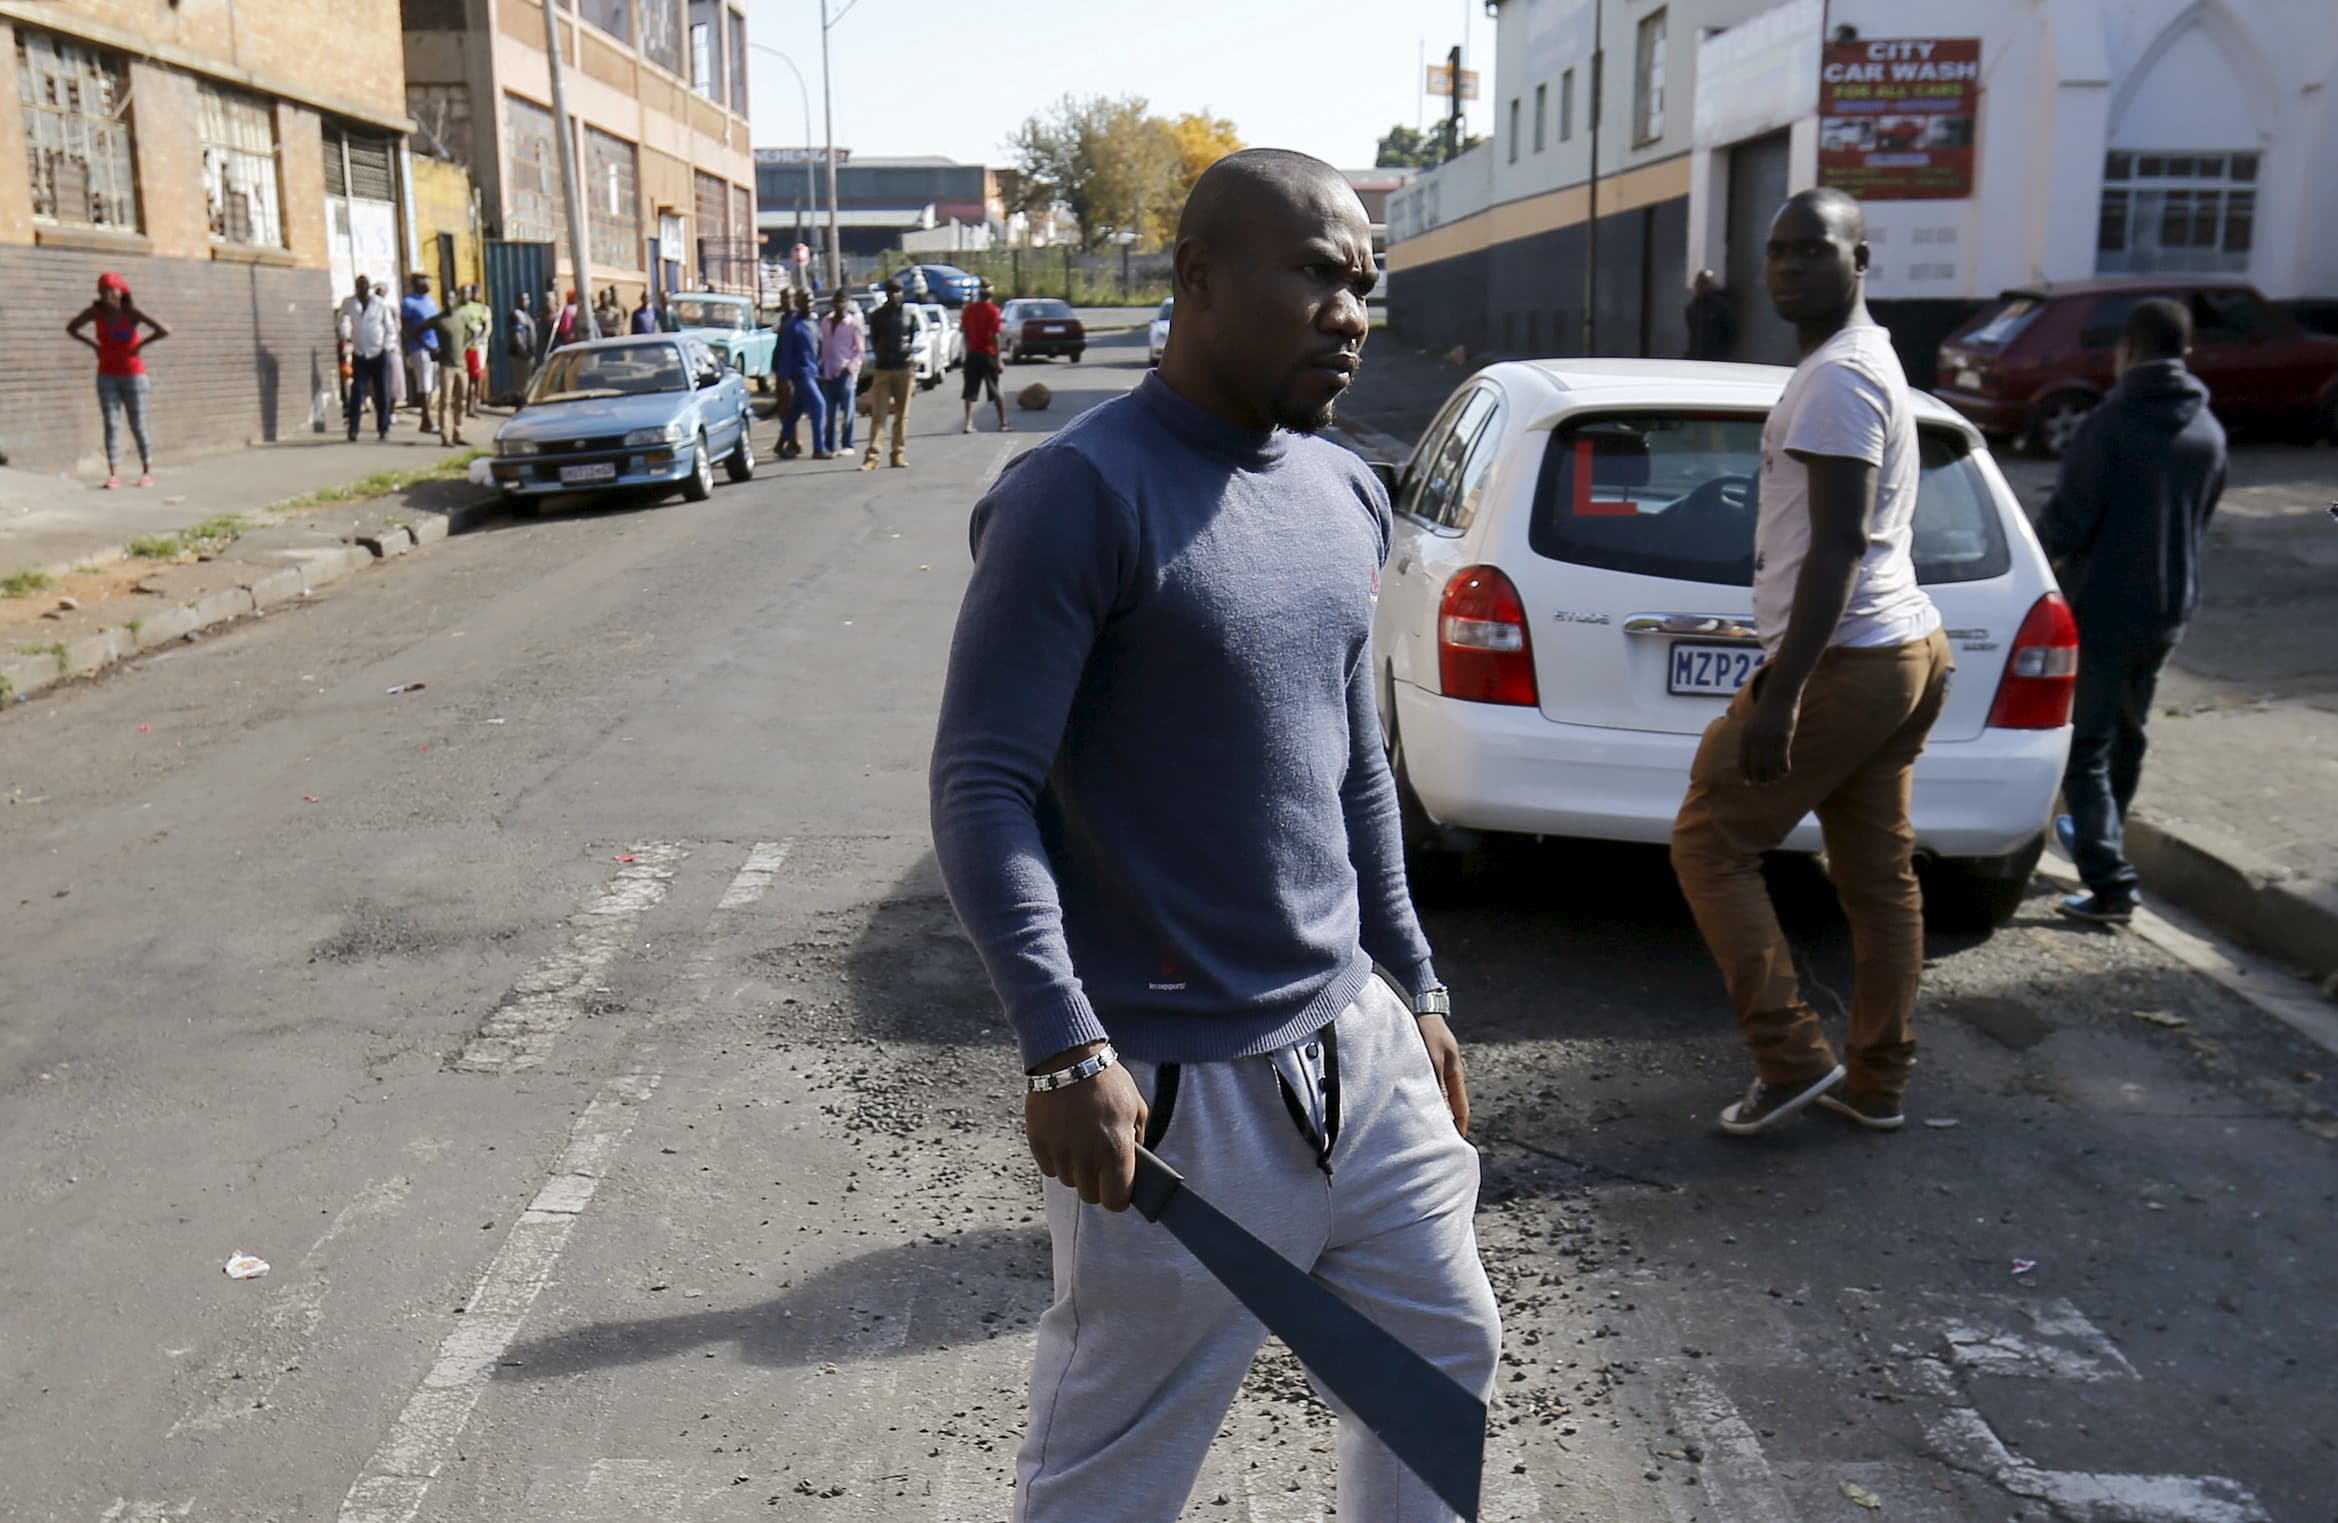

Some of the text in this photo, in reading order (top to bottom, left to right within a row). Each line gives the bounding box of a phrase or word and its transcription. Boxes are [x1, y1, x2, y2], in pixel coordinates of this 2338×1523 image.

[1867, 41, 1935, 60] CITY
[1823, 61, 1978, 83] CAR WASH
[1833, 83, 1962, 98] FOR ALL CARS
